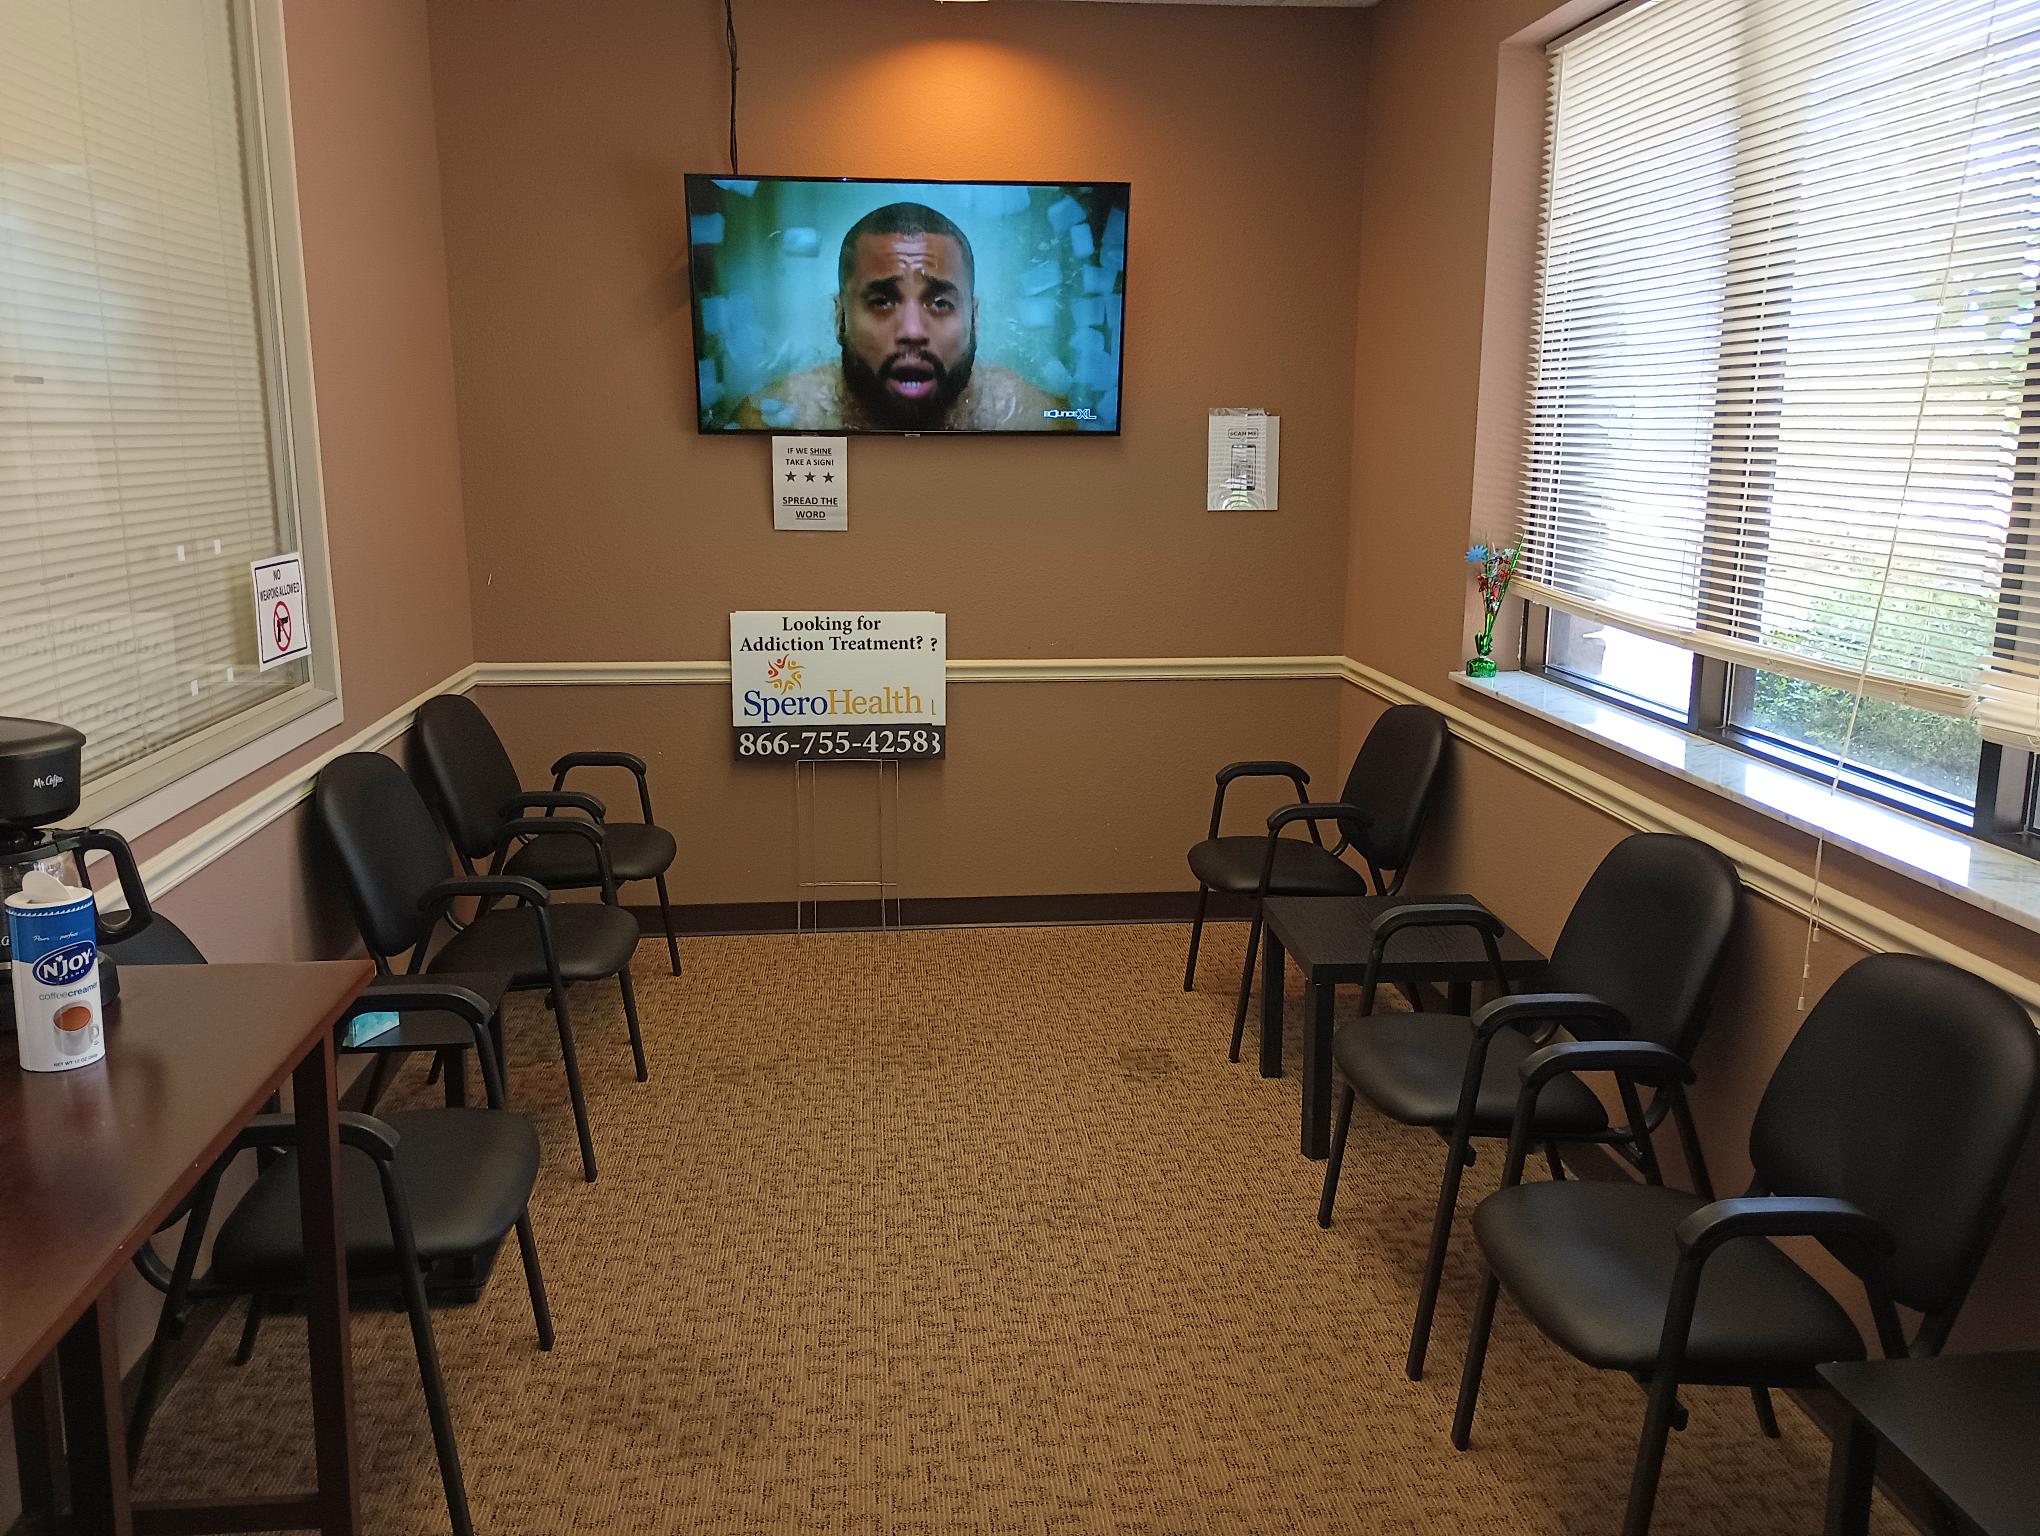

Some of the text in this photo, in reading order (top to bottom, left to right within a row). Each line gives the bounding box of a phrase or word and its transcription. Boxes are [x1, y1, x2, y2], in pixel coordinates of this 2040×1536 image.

[809, 447, 832, 455] SHINE
[785, 458, 805, 466] TAKE
[782, 496, 838, 505] SPREAD THE
[795, 510, 826, 519] WORD
[273, 568, 281, 581] NO
[260, 582, 300, 602] WEAPONS ALLOWED
[782, 615, 881, 635] Looking for
[739, 635, 924, 652] Addiction Treatment?
[33, 777, 46, 789] Mr.
